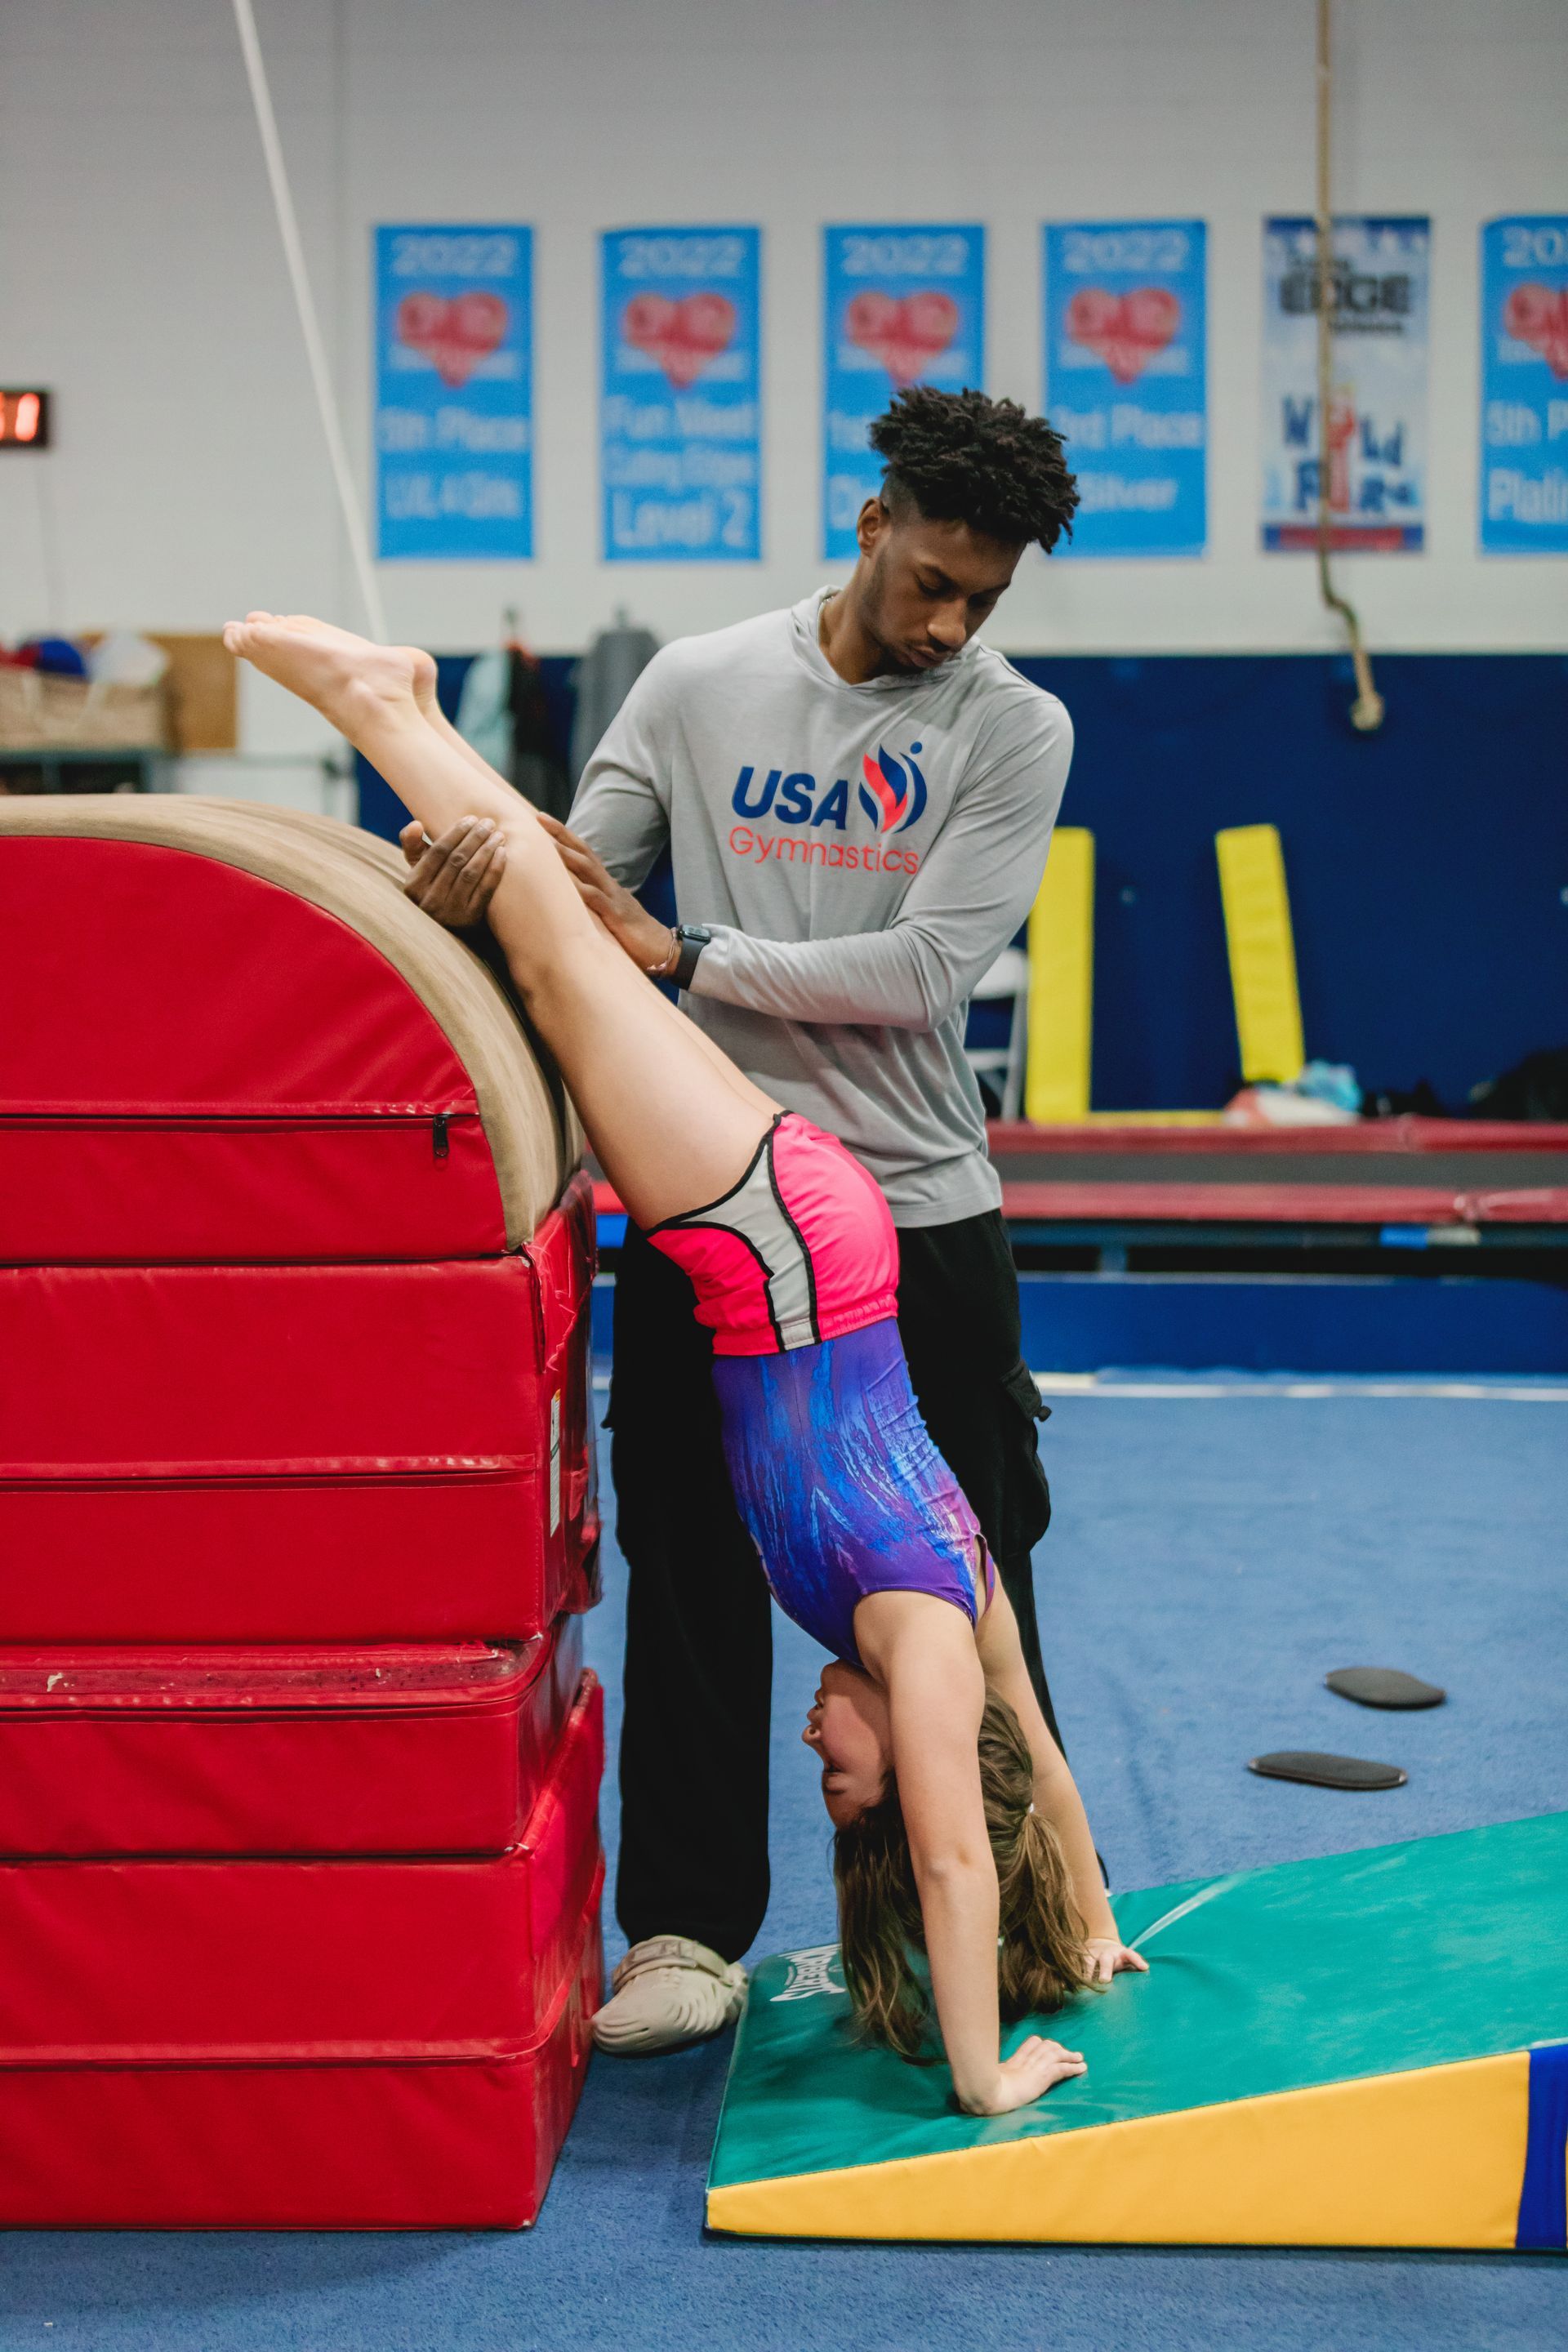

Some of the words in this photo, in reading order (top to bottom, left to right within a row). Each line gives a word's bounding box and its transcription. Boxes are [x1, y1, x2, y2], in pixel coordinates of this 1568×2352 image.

[392, 234, 518, 277] 2022
[619, 234, 745, 278] 2022
[841, 234, 969, 276] 2022
[1062, 229, 1189, 272] 2022
[1502, 225, 1568, 268] 20
[731, 765, 849, 831] USA
[729, 826, 920, 875] Gymnastics
